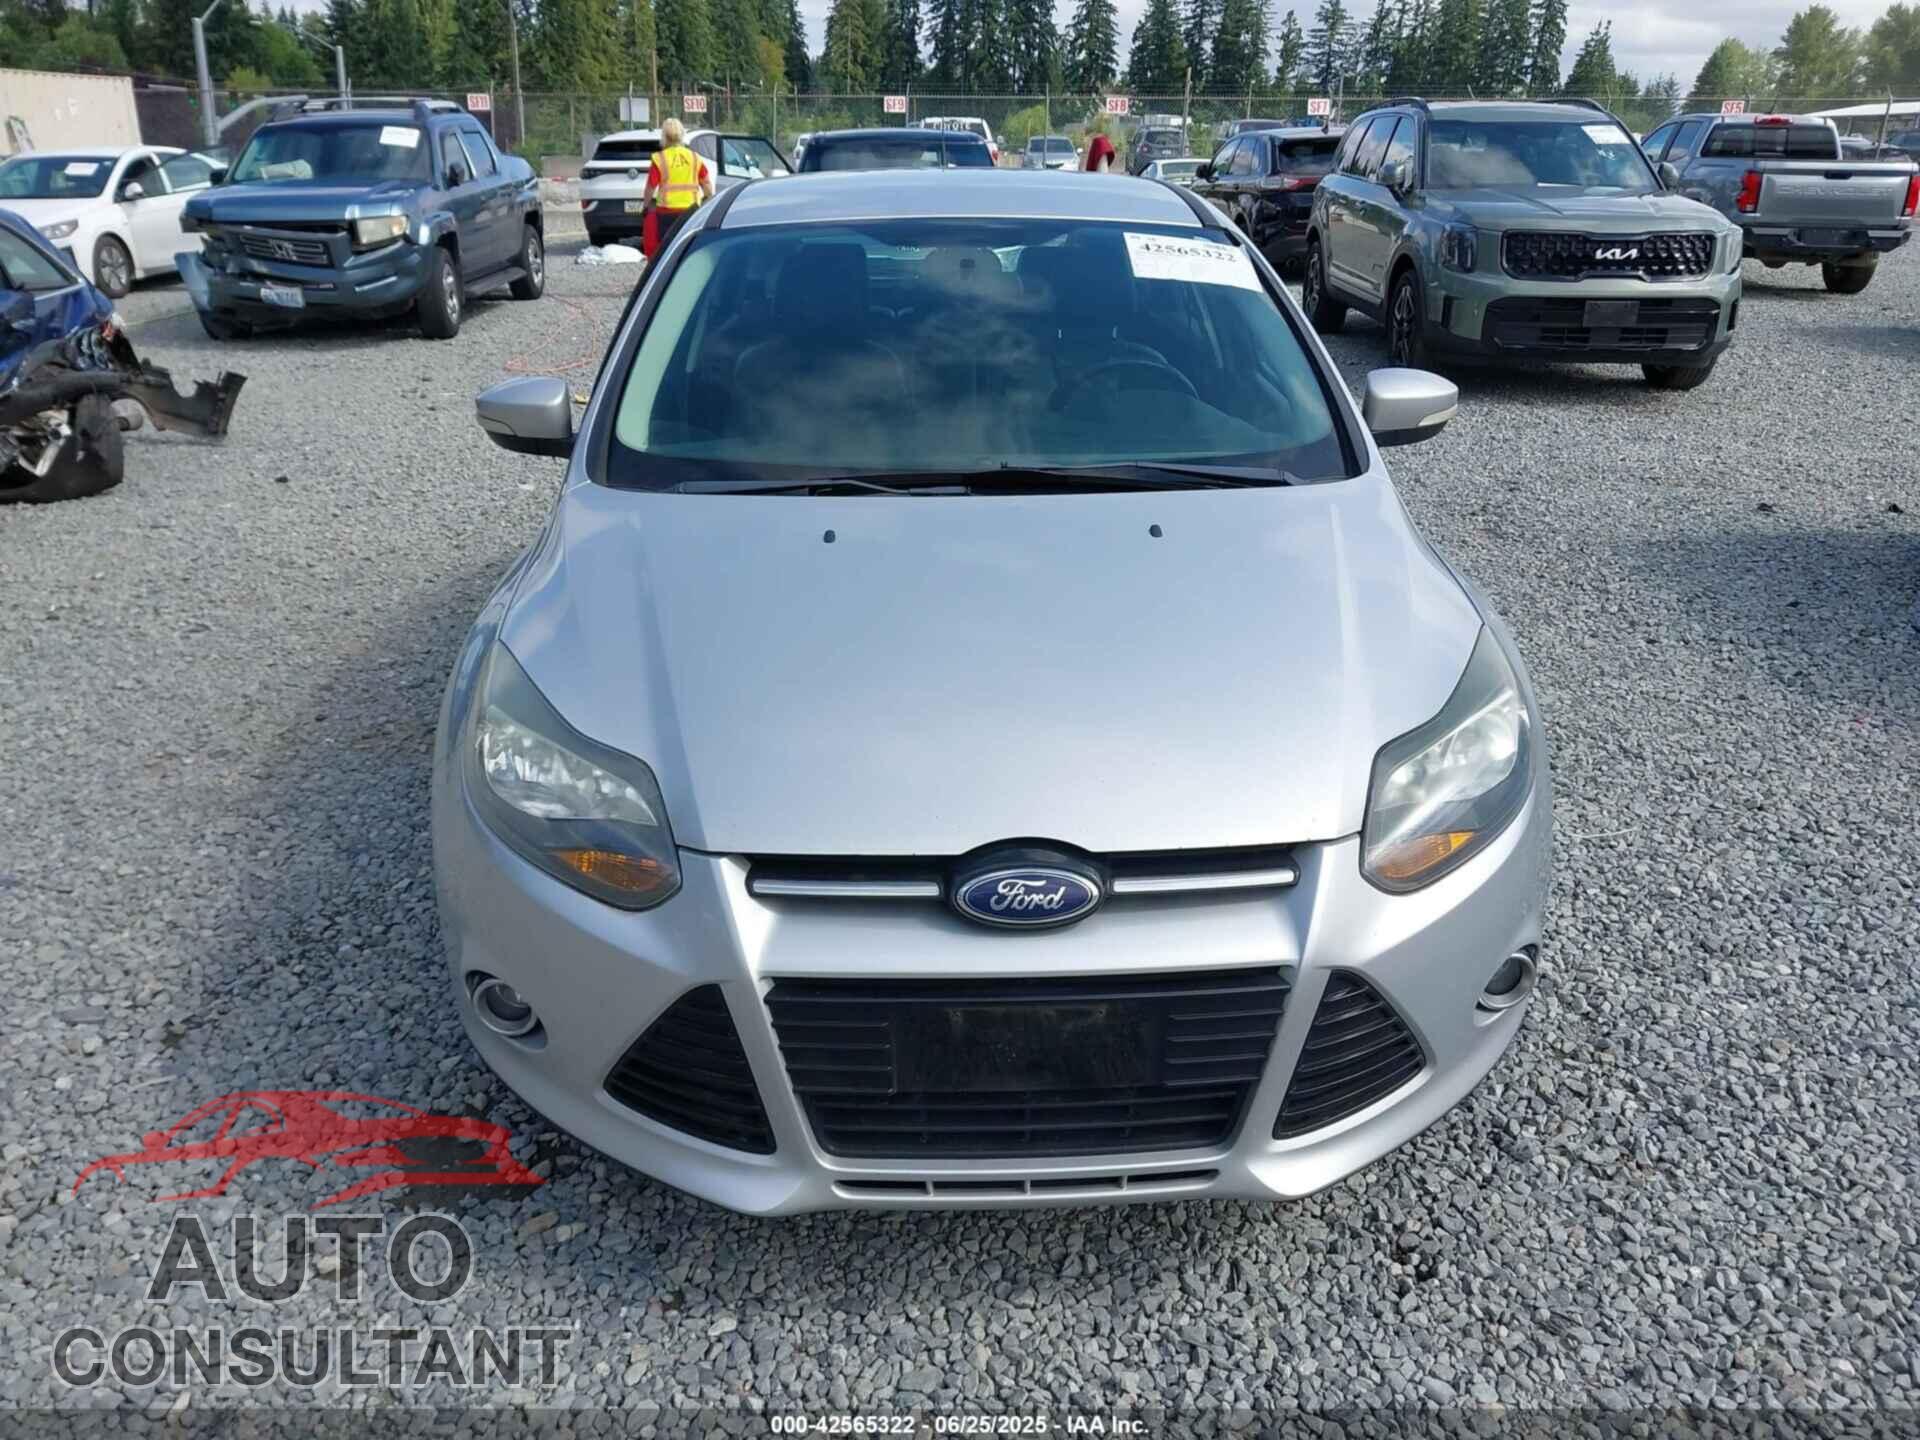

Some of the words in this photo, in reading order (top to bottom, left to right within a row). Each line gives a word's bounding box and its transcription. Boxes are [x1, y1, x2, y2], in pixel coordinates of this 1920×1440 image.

[685, 98, 705, 110] SF10
[886, 101, 904, 111] SF9
[1109, 100, 1126, 112] SF8
[1311, 101, 1328, 113] SF7
[1724, 102, 1743, 114] SF5
[1139, 242, 1237, 263] 42565322
[990, 879, 1066, 911] Ford
